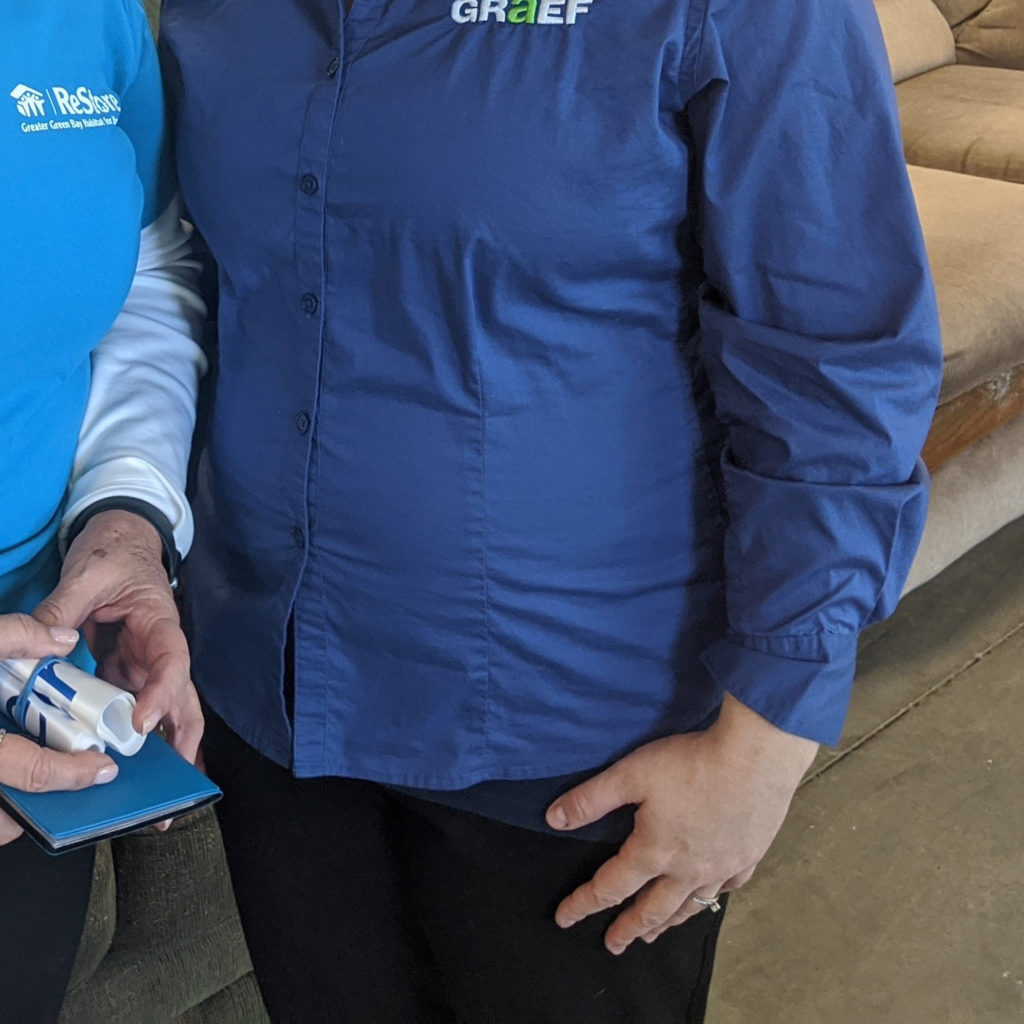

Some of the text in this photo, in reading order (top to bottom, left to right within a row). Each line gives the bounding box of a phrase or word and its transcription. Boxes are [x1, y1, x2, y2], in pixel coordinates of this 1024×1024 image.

[52, 86, 121, 115] ReStore
[21, 121, 48, 133] Greater
[49, 119, 70, 130] Green
[70, 118, 83, 130] Bay
